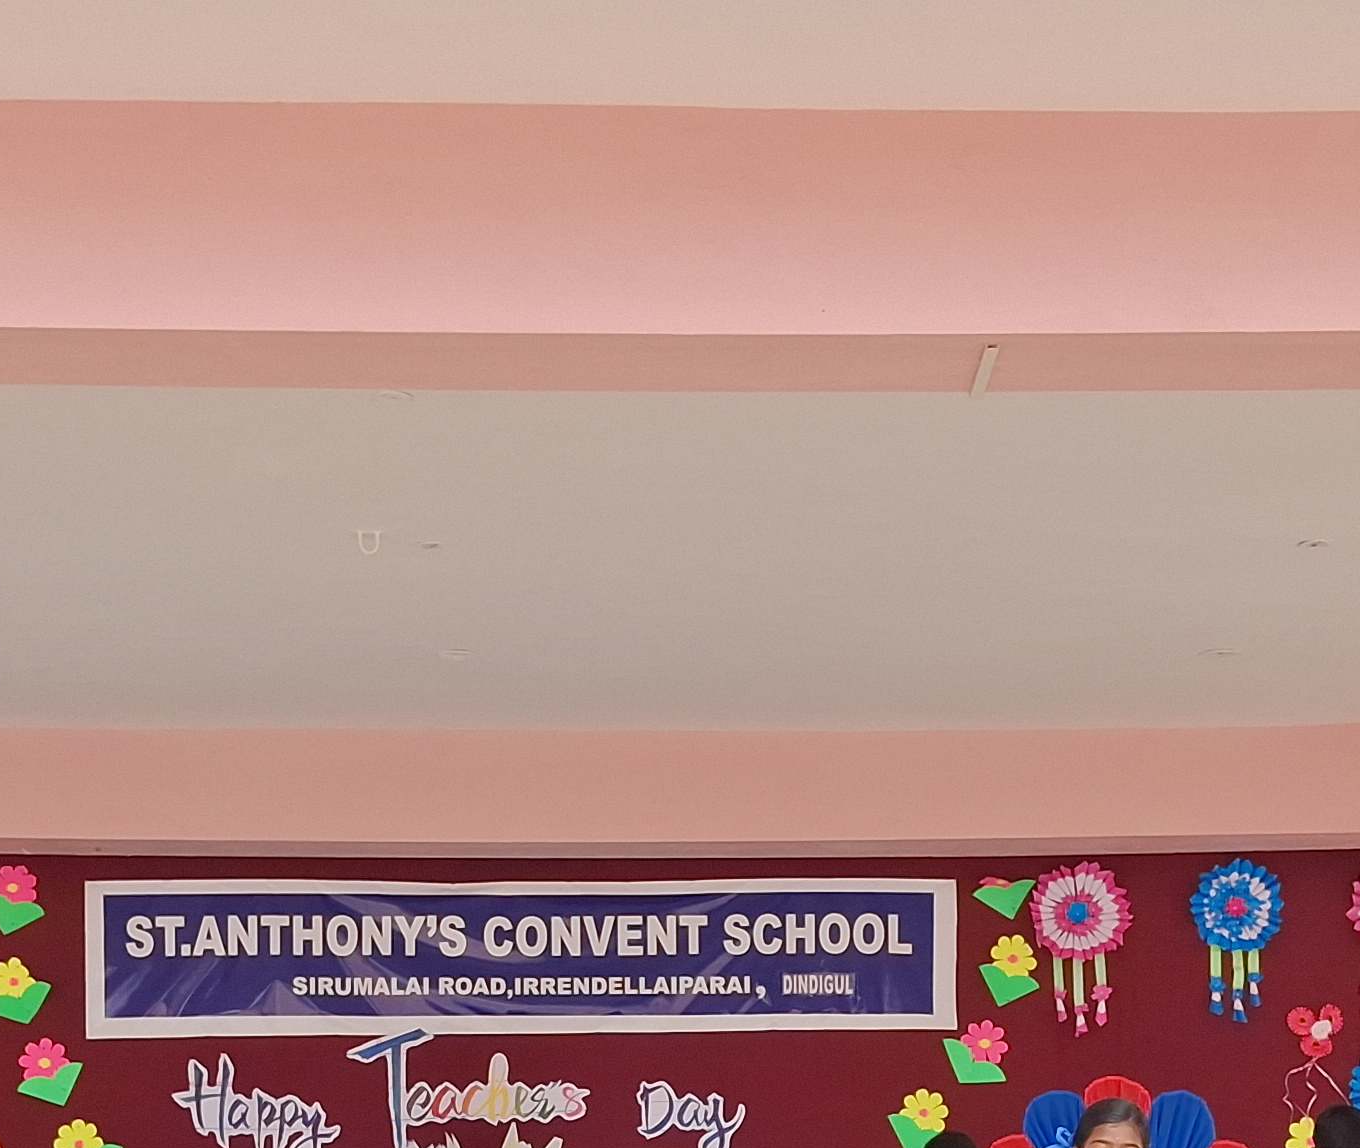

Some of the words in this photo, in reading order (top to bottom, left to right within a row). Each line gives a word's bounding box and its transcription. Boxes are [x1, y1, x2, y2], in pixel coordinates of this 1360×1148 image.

[125, 914, 467, 958] ST.ANTHONY'S
[483, 914, 709, 957] CONVENT
[721, 912, 913, 956] SCHOOL
[292, 976, 430, 997] SIRUMALAI
[782, 974, 854, 996] DINDIGUL
